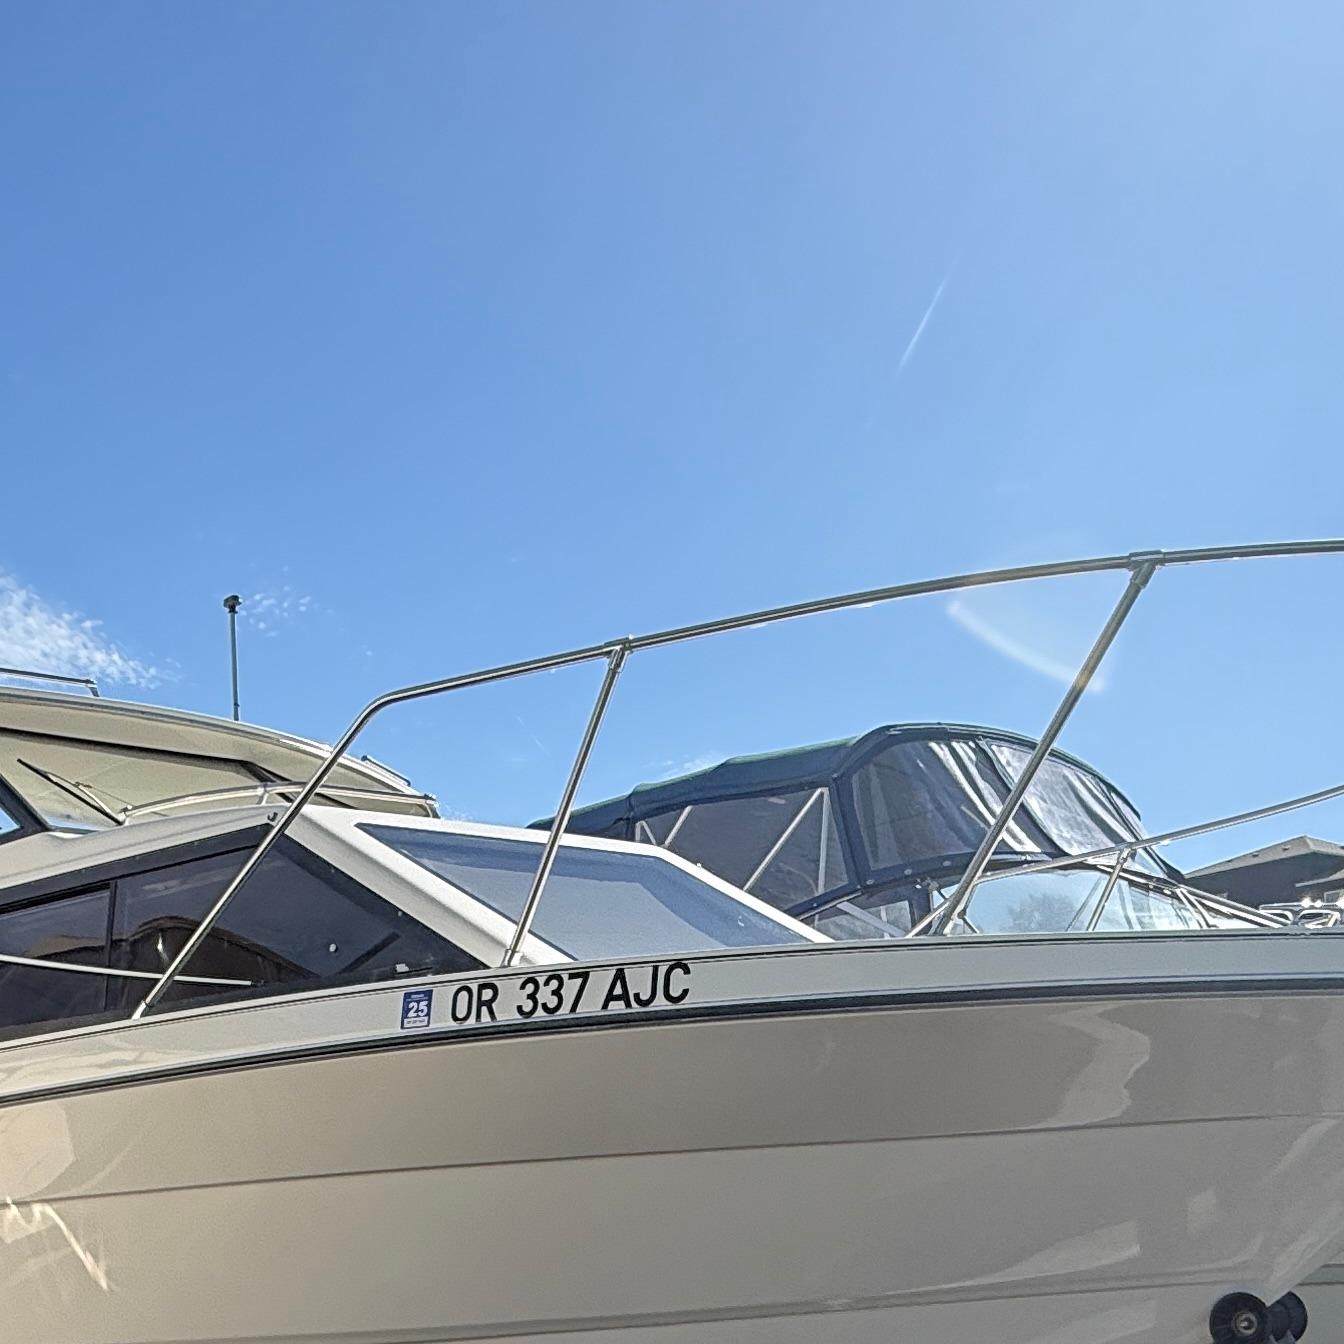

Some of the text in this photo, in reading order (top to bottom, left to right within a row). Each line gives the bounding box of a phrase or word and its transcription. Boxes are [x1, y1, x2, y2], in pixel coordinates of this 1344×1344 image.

[406, 1000, 429, 1018] 25
[450, 961, 692, 1025] OR 337 AJC
